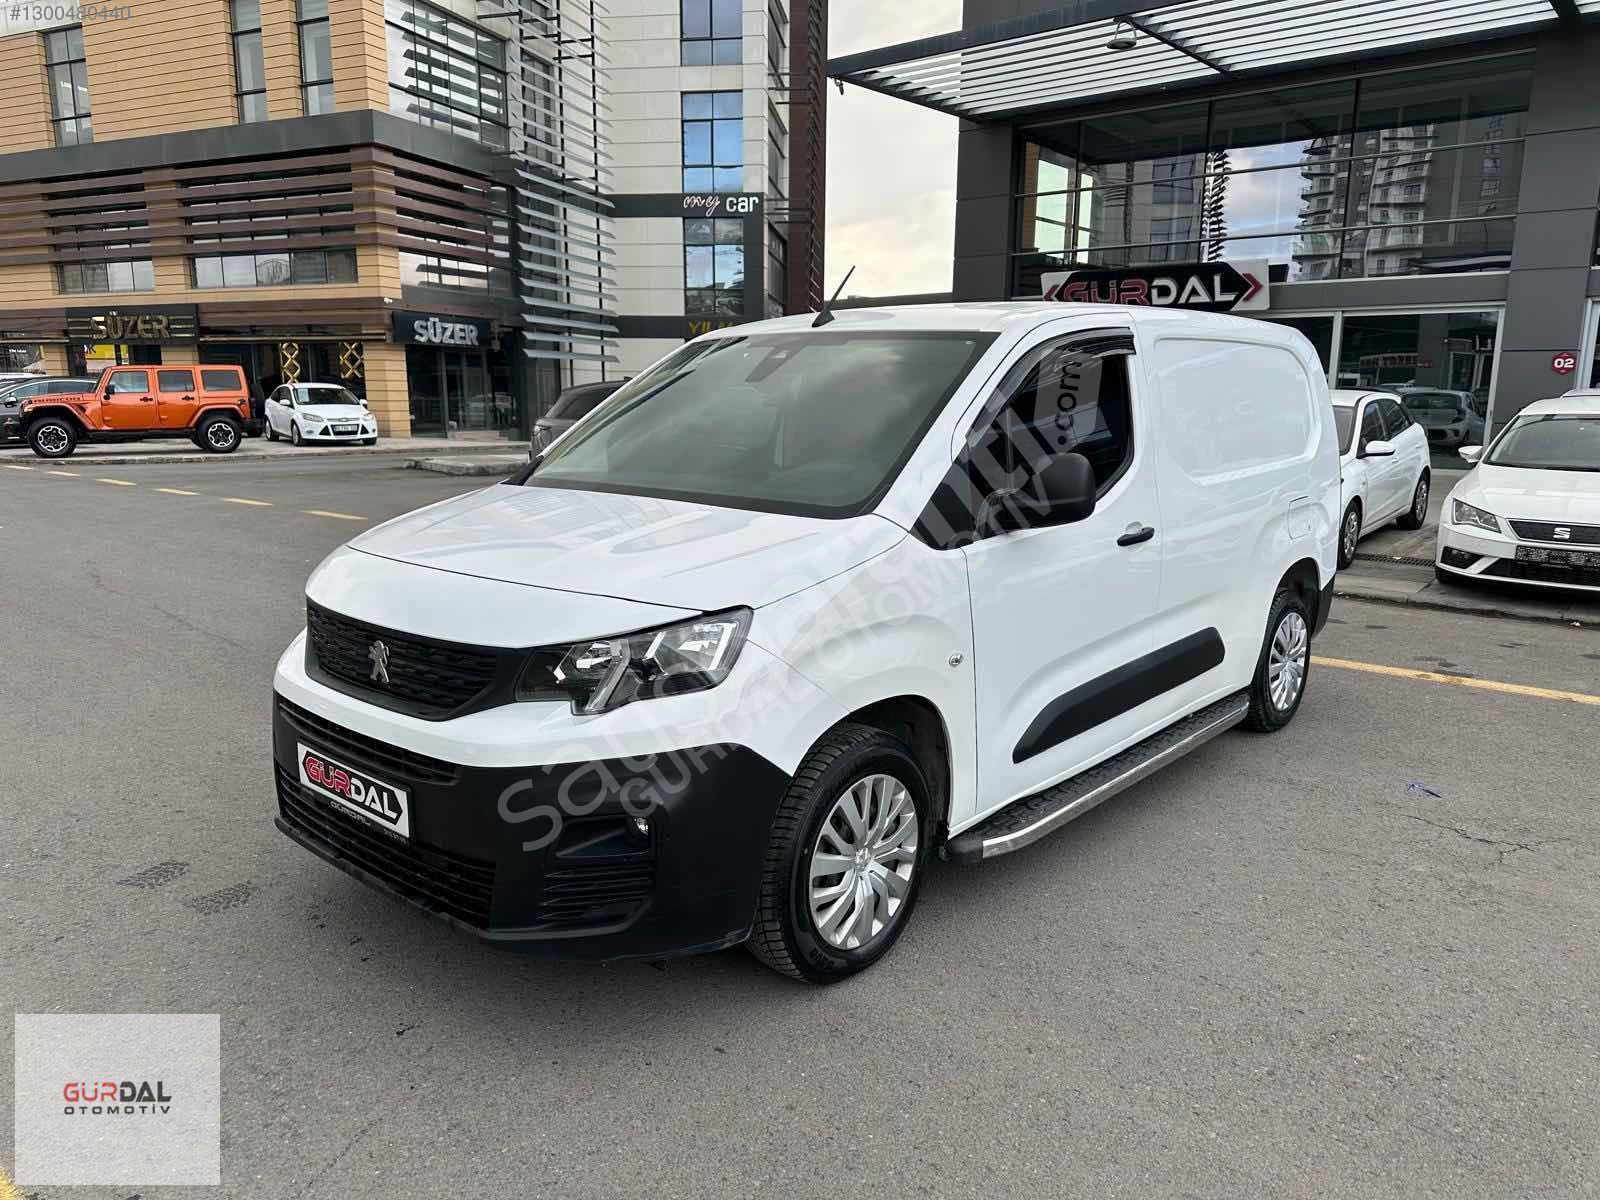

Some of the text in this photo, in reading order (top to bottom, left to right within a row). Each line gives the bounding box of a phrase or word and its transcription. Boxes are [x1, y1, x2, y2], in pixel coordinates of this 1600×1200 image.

[726, 196, 759, 213] car
[90, 310, 170, 340] SÜZER
[414, 317, 479, 346] SÜZER
[1554, 358, 1575, 369] 02
